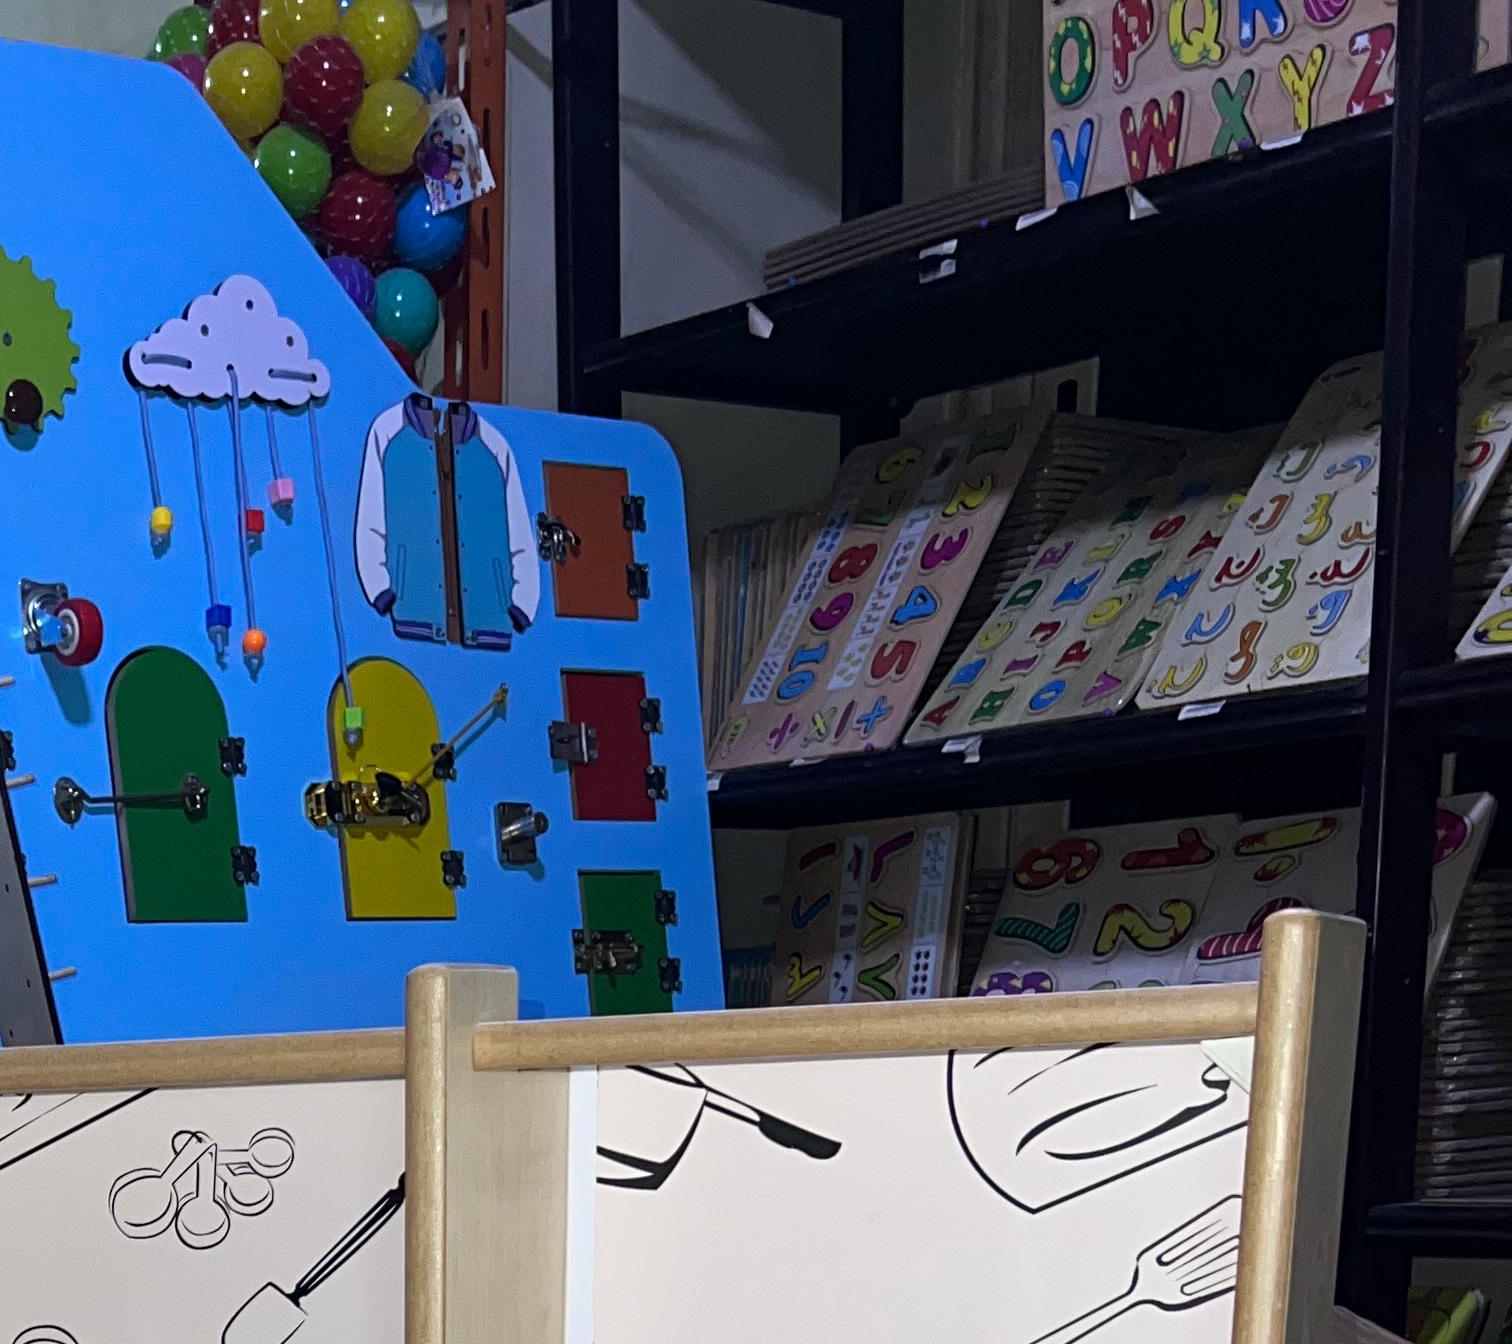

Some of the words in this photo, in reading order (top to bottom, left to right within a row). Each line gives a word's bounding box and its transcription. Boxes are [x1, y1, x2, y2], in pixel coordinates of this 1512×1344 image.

[1049, 16, 1095, 105] O
[1112, 0, 1153, 87] P
[1169, 0, 1225, 65] Q
[1051, 118, 1094, 199] V
[1120, 90, 1184, 182] W
[1211, 69, 1257, 158] X
[1278, 44, 1326, 129] Y
[1348, 23, 1395, 117] Z
[942, 473, 993, 517] 2
[828, 543, 878, 583] 8
[920, 528, 969, 571] 3
[810, 592, 854, 630] 9
[890, 585, 938, 625] 4
[1056, 640, 1092, 669] P
[1116, 551, 1162, 586] R
[1149, 515, 1186, 541] S
[870, 640, 917, 679] 5
[921, 696, 960, 727] A
[1004, 578, 1043, 610] D
[1033, 541, 1073, 570] E
[970, 688, 1014, 721] H
[1052, 568, 1101, 606] K
[1083, 671, 1121, 708] V
[1118, 617, 1161, 655] W
[1014, 838, 1100, 890] 6
[1093, 898, 1194, 956] 2
